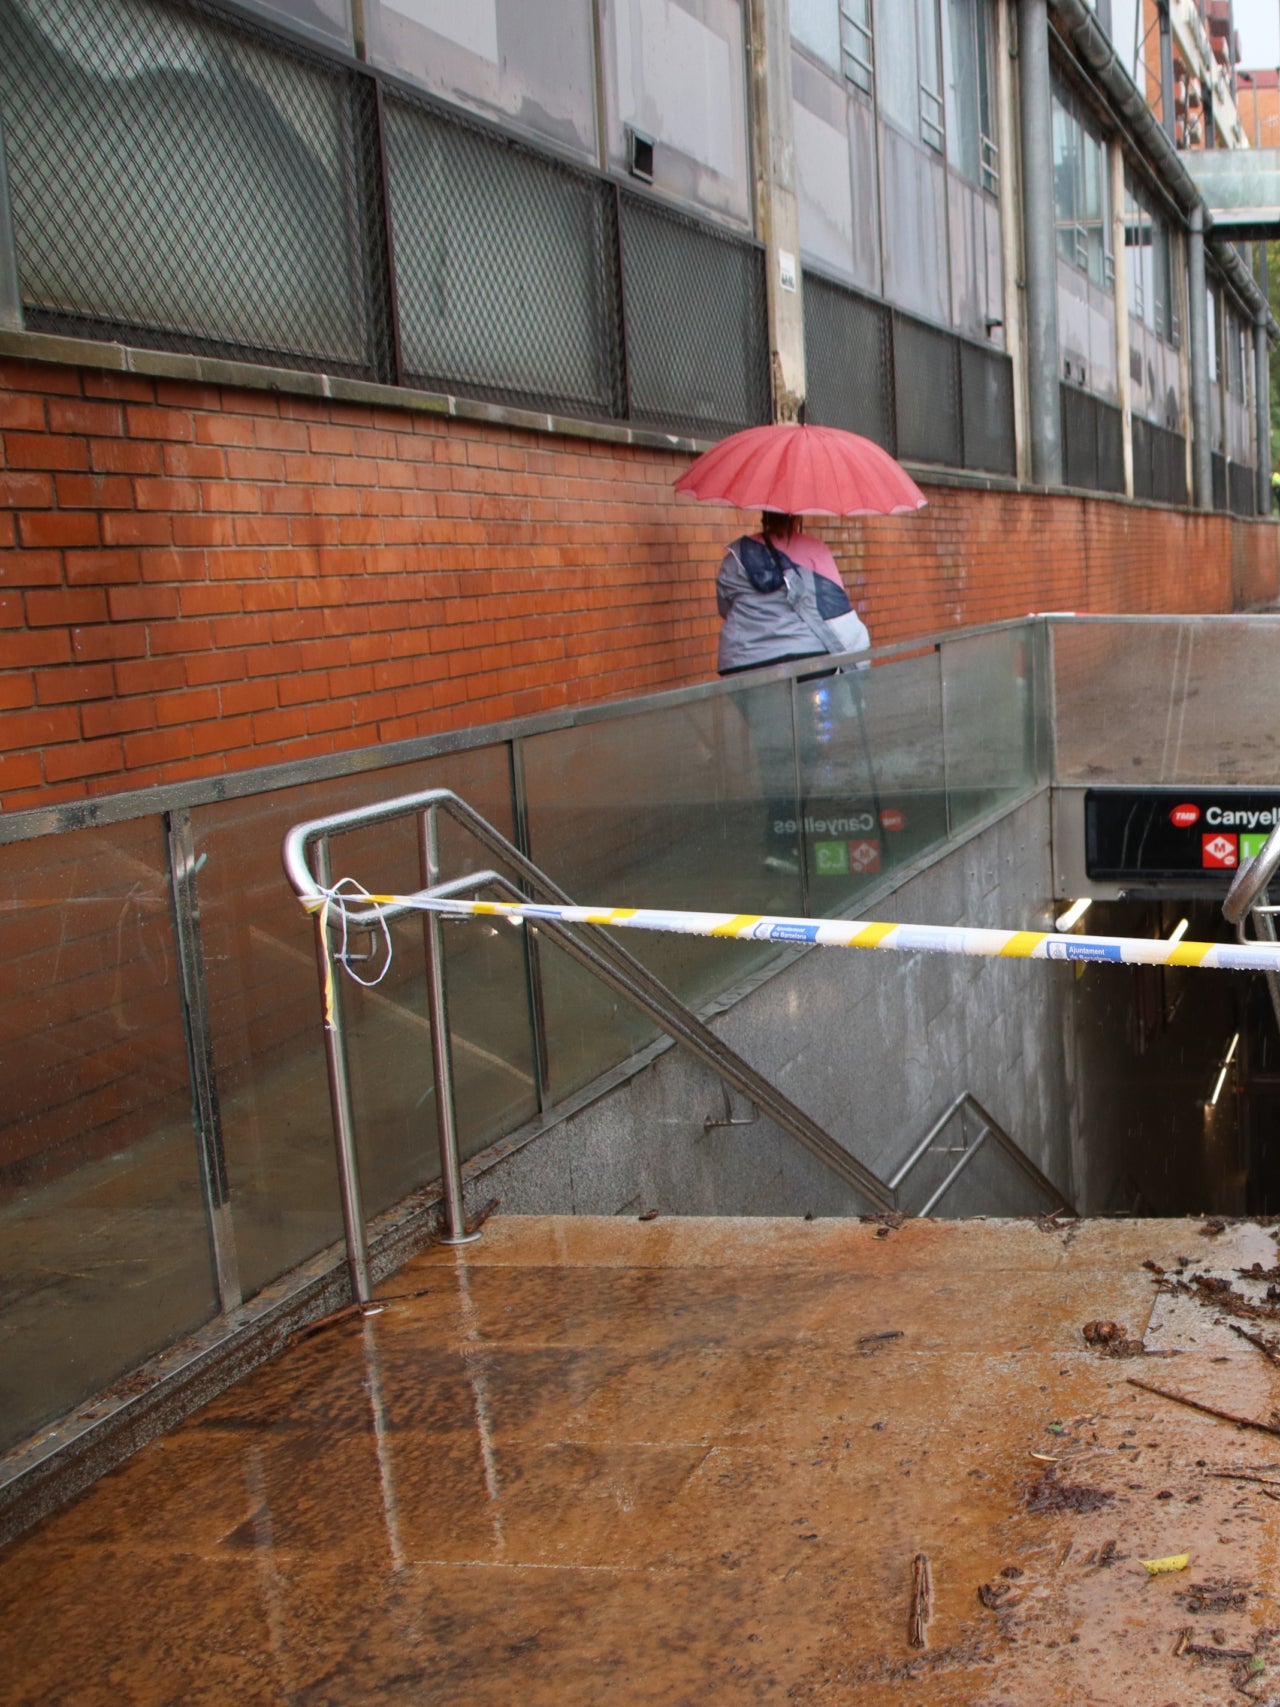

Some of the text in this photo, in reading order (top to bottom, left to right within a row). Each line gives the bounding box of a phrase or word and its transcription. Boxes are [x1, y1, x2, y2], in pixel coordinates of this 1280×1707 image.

[1175, 812, 1197, 821] TMB
[1214, 843, 1226, 853] M
[1069, 946, 1105, 955] Ajuntament
